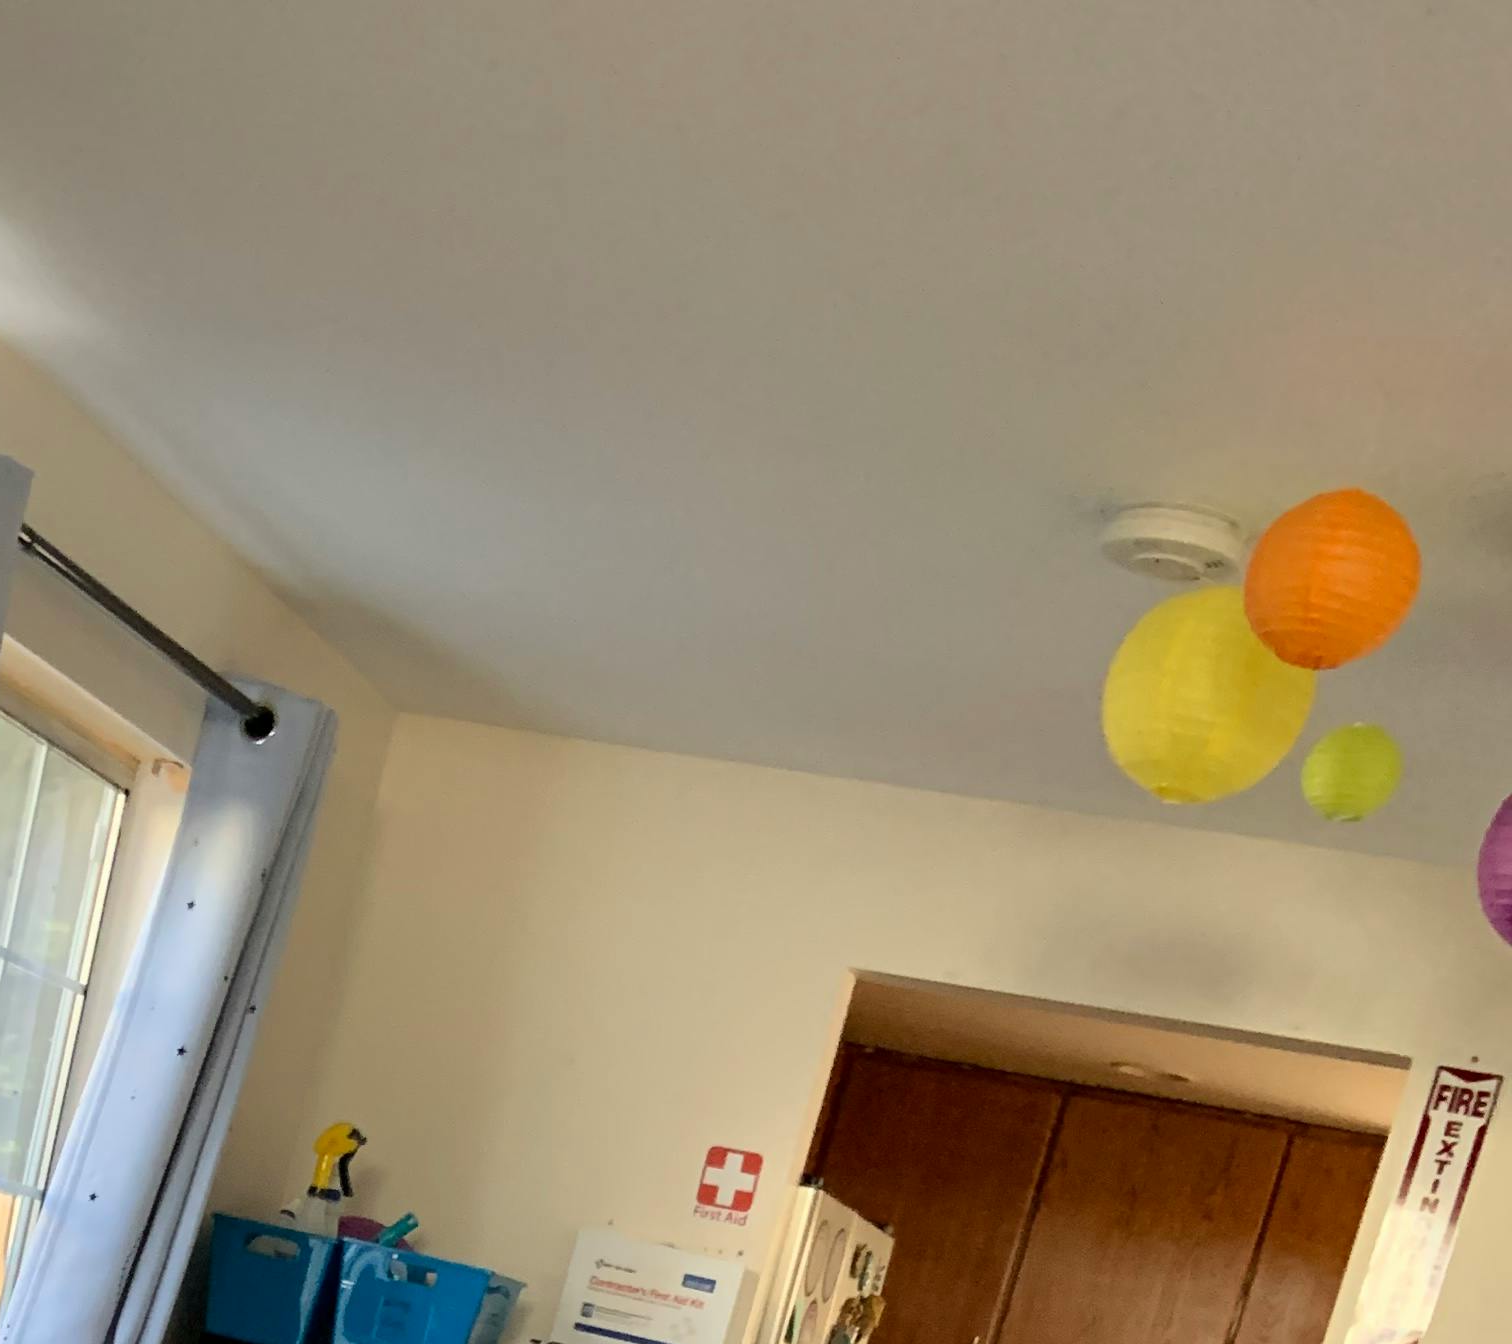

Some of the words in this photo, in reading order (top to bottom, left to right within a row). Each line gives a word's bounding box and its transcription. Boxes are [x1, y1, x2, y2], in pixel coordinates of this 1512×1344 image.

[1433, 1083, 1491, 1118] FIRE
[693, 1205, 722, 1221] First
[724, 1211, 749, 1227] Aid
